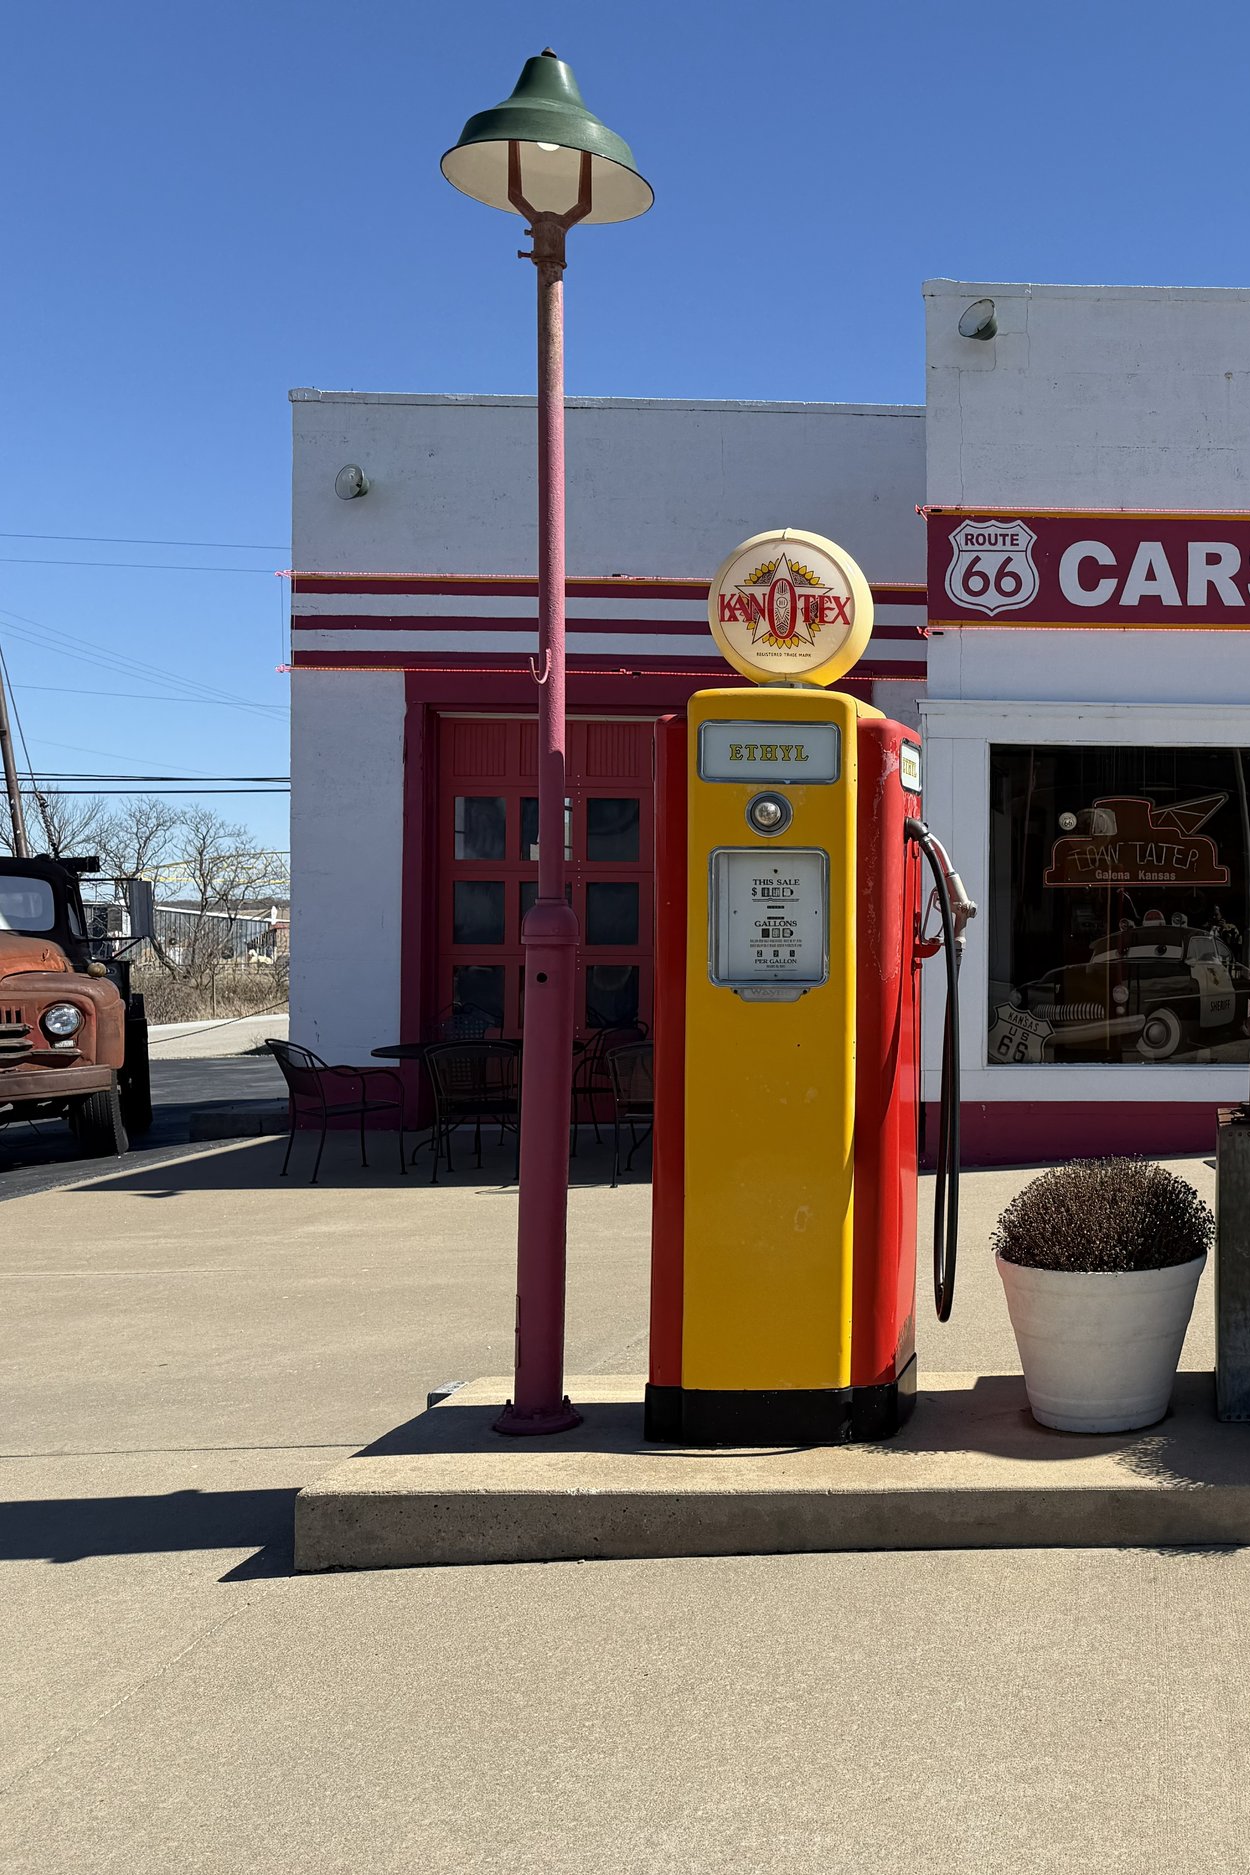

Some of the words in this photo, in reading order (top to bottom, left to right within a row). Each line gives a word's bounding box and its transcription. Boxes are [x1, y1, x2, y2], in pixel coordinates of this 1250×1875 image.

[964, 532, 1020, 547] ROUTE
[961, 554, 1023, 598] 66
[729, 743, 809, 762] ETHYL
[752, 878, 774, 886] THIS
[776, 878, 800, 886] SALE
[1095, 869, 1130, 880] Galena
[1138, 869, 1176, 881] Kansas
[754, 920, 798, 928] GALLONS
[1210, 999, 1231, 1012] SHERIFF
[1008, 1012, 1040, 1032] KANSAS
[997, 1034, 1029, 1063] 66
